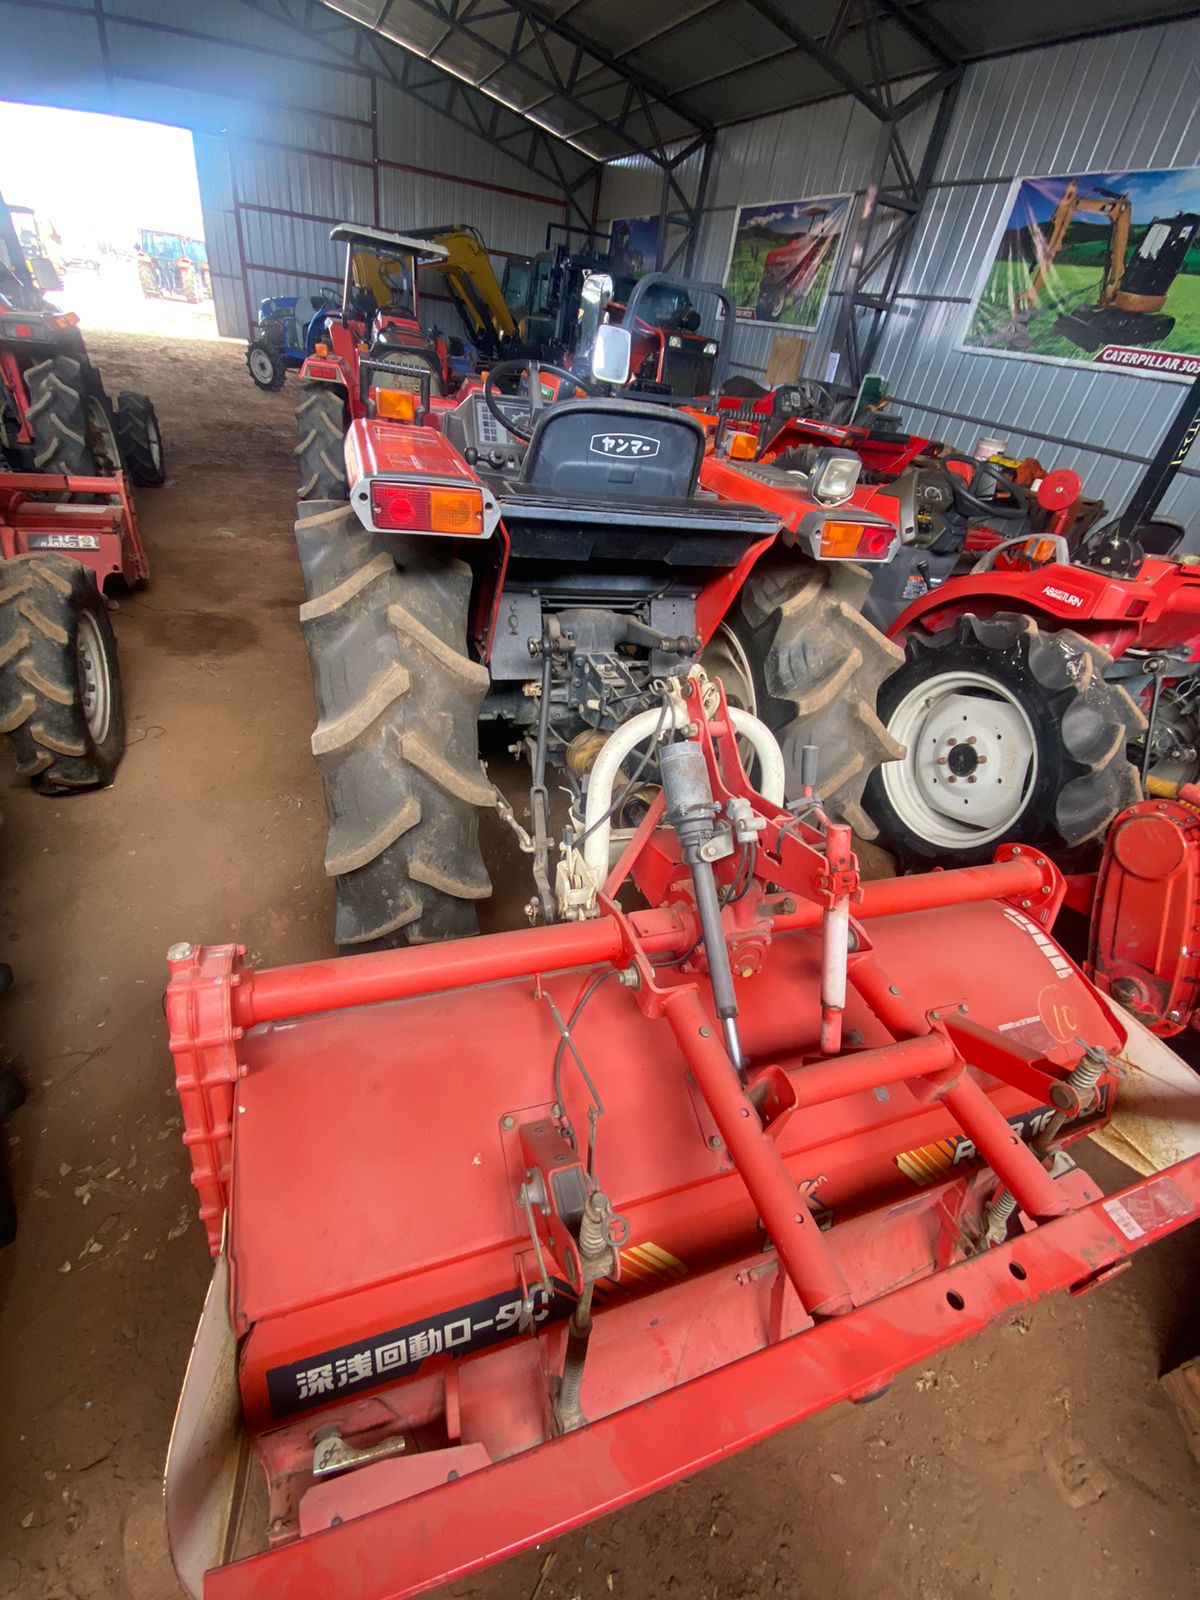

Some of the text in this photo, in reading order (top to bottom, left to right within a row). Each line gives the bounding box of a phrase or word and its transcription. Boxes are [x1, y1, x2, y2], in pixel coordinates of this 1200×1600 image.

[1103, 350, 1179, 370] CATERPILLAR
[602, 437, 650, 454] ヤンマー
